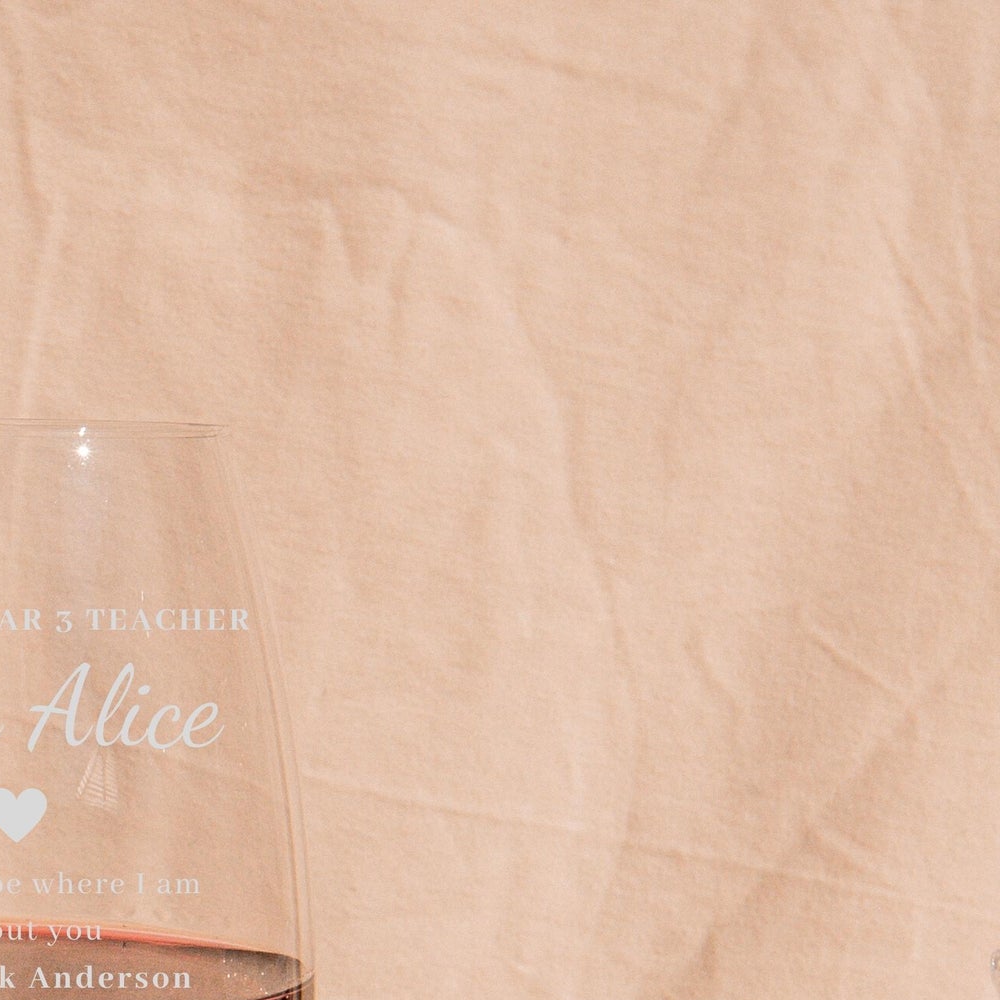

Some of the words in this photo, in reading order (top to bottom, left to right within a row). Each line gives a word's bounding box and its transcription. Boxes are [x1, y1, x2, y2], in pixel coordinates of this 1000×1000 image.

[55, 610, 73, 633] 3
[86, 608, 250, 631] TEACHER
[27, 662, 225, 753] Alice
[32, 871, 125, 895] where
[137, 872, 145, 894] I
[157, 878, 201, 895] am
[47, 923, 102, 947] you
[28, 965, 192, 989] Anderson
